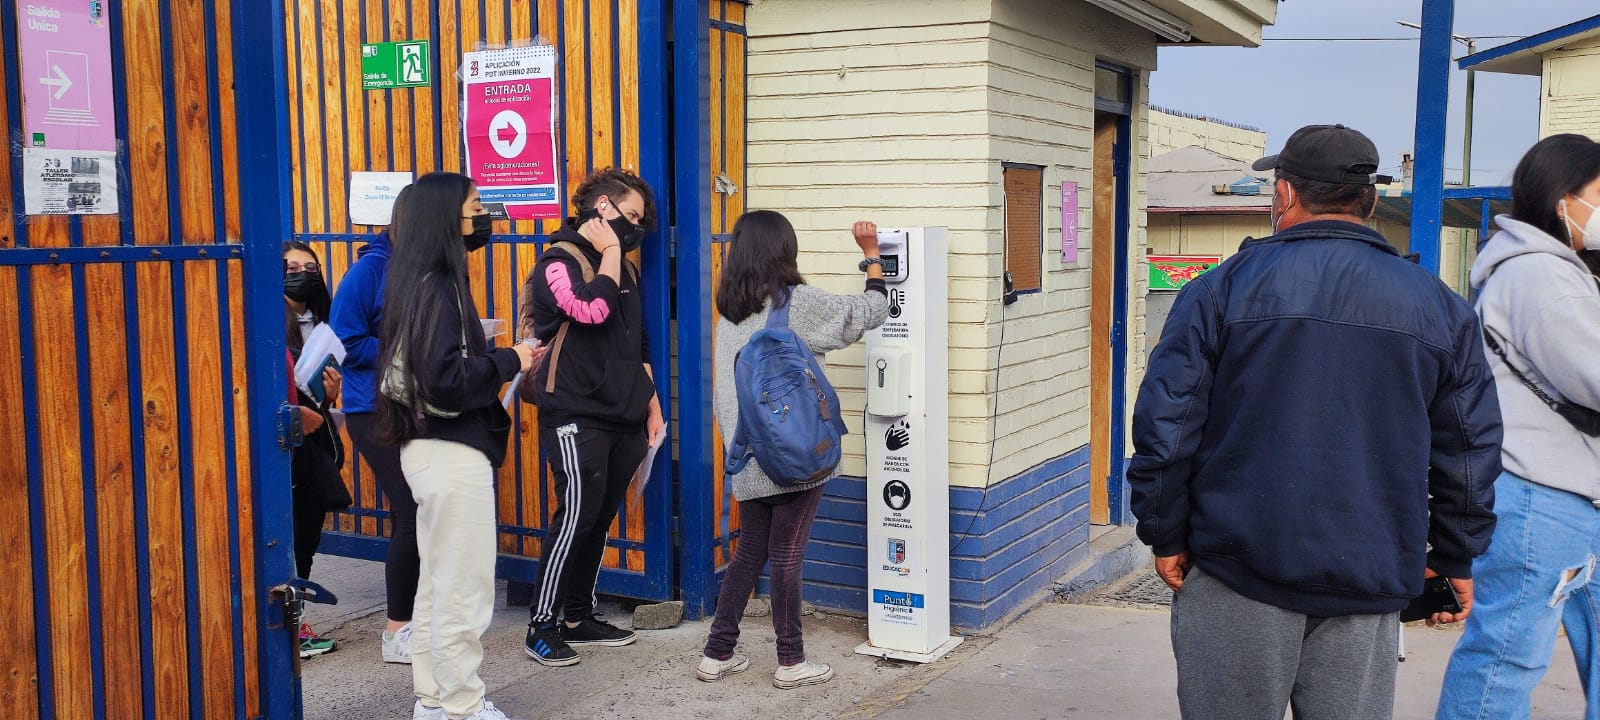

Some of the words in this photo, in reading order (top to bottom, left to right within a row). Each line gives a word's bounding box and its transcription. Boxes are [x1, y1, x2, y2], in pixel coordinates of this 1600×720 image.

[27, 4, 60, 19] Salida
[28, 19, 58, 33] Unica
[470, 61, 479, 69] 20
[470, 68, 479, 77] 23
[526, 67, 541, 75] 2022
[485, 84, 531, 96] ENTRADA
